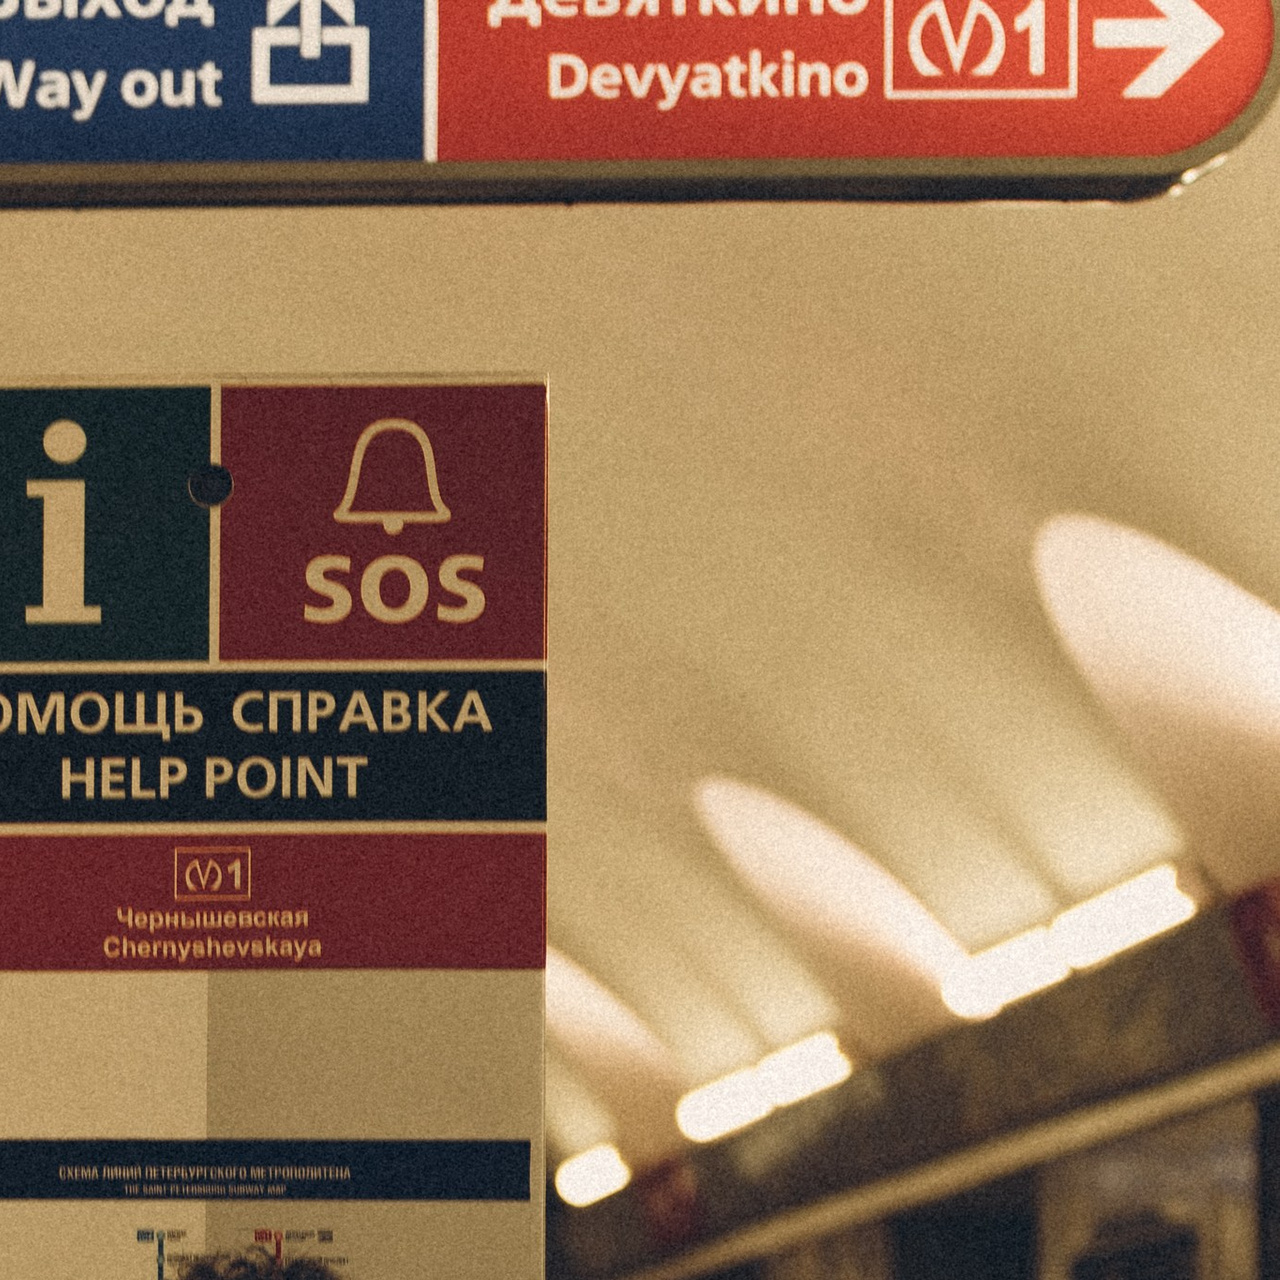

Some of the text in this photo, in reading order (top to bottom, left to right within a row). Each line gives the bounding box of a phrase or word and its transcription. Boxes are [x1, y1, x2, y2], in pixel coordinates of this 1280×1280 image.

[121, 60, 223, 109] out
[548, 49, 870, 111] Devyatkino
[303, 554, 487, 624] SOS
[231, 690, 493, 734] СПРАВКА
[60, 755, 368, 799] HELP POINT
[116, 906, 309, 934] Чернышевская
[103, 935, 322, 963] Chernyshevskaya
[58, 1165, 99, 1180] СХЕМА
